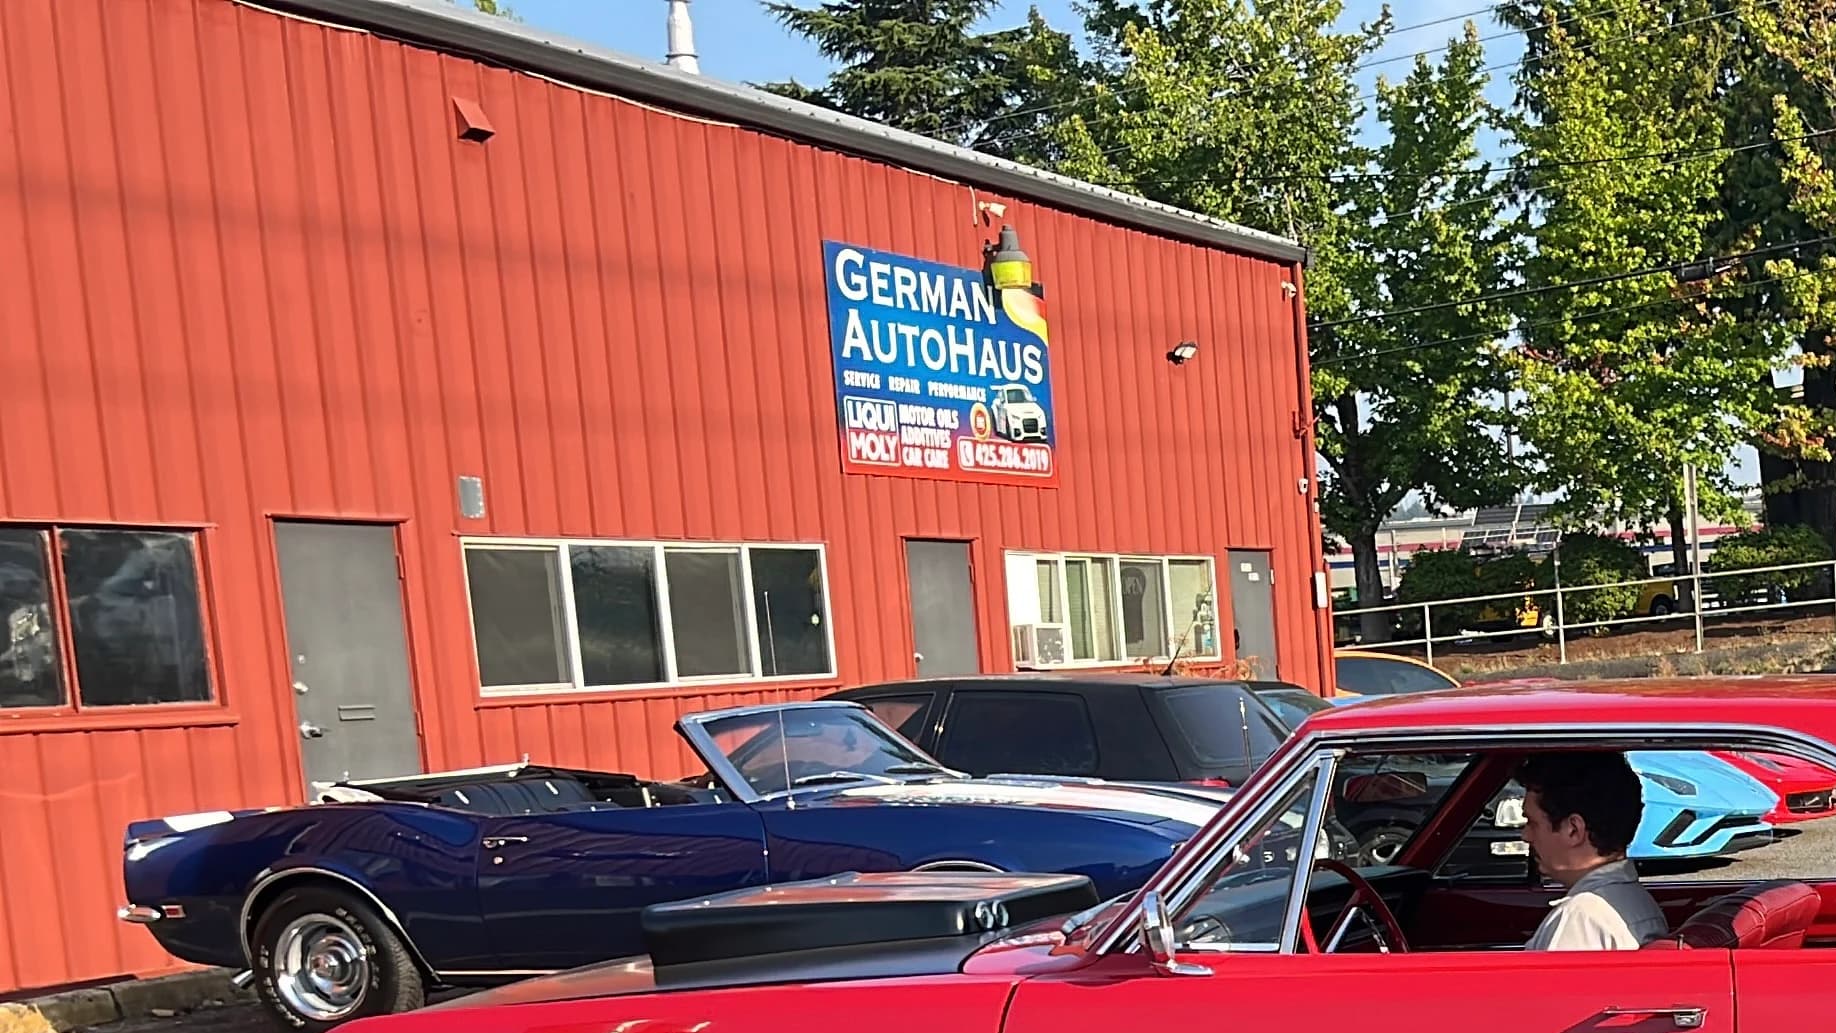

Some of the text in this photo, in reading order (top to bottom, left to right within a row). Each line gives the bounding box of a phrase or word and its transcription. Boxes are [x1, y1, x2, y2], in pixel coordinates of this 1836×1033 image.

[835, 248, 997, 324] GERMAN
[843, 369, 987, 402] SERVICE REPAIR PERFORMANCE
[847, 400, 896, 432] LIQUI
[898, 404, 936, 427] MOTOR
[936, 408, 959, 430] OILS
[849, 431, 898, 462] MOLY
[900, 425, 952, 449] ADDITIVES
[902, 446, 950, 469] CAR CARE
